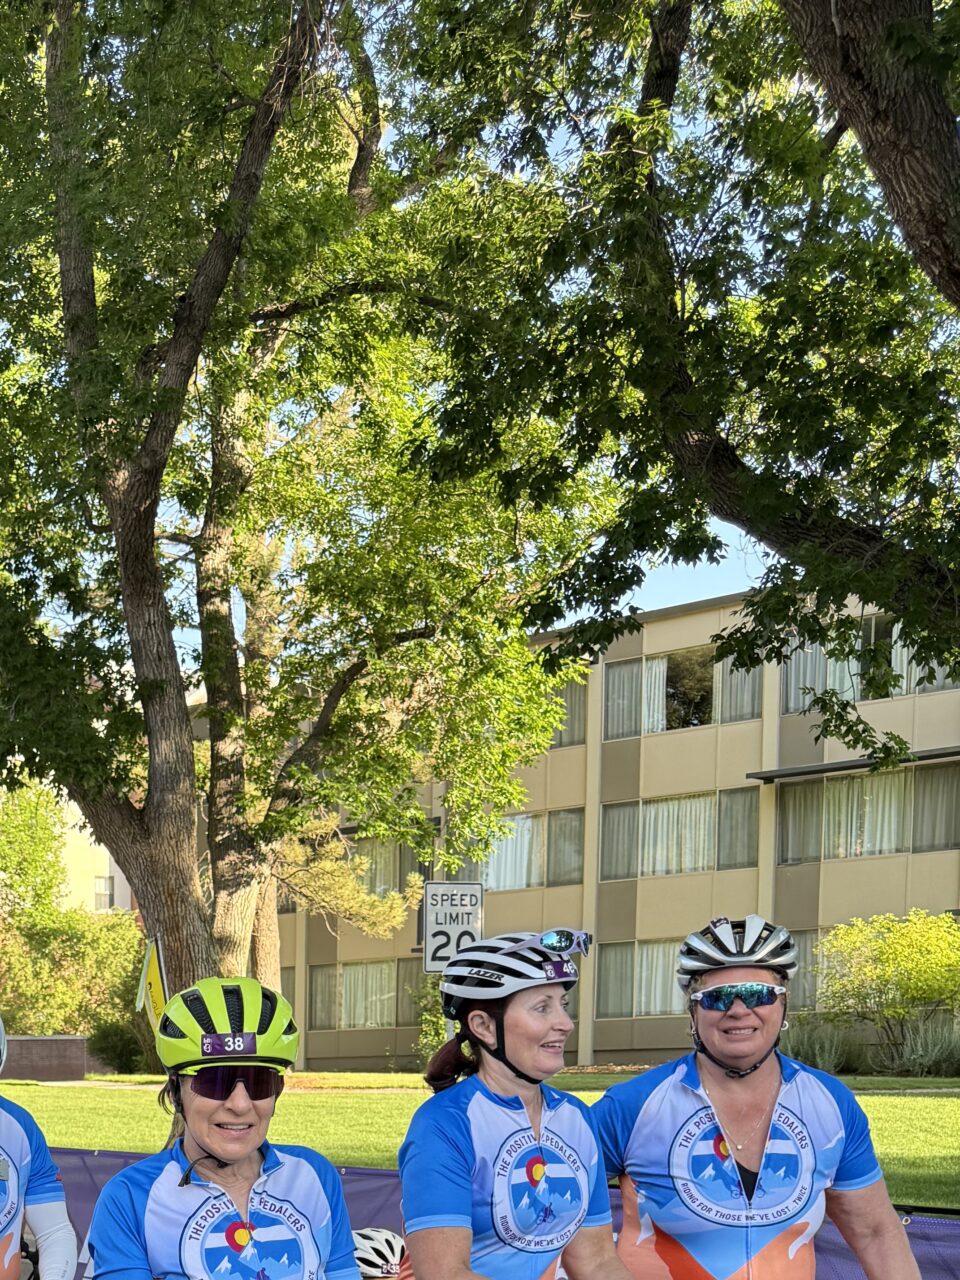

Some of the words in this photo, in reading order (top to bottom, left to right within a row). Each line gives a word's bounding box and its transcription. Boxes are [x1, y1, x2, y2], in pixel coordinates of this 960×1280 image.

[430, 893, 478, 907] SPEED
[435, 912, 472, 926] LIMIT
[430, 930, 476, 962] 20
[468, 968, 505, 982] LAZER
[224, 1037, 244, 1051] 38
[678, 1130, 697, 1149] THE
[776, 1111, 809, 1150] EDALERS
[497, 1157, 511, 1178] THE
[545, 1135, 581, 1173] PEDALERS
[680, 1182, 699, 1205] RIDING
[697, 1202, 713, 1215] FOR
[714, 1210, 742, 1222] THOSE
[189, 1219, 206, 1241] THE
[258, 1197, 306, 1233] PEDALERS
[500, 1215, 512, 1237] RIDING
